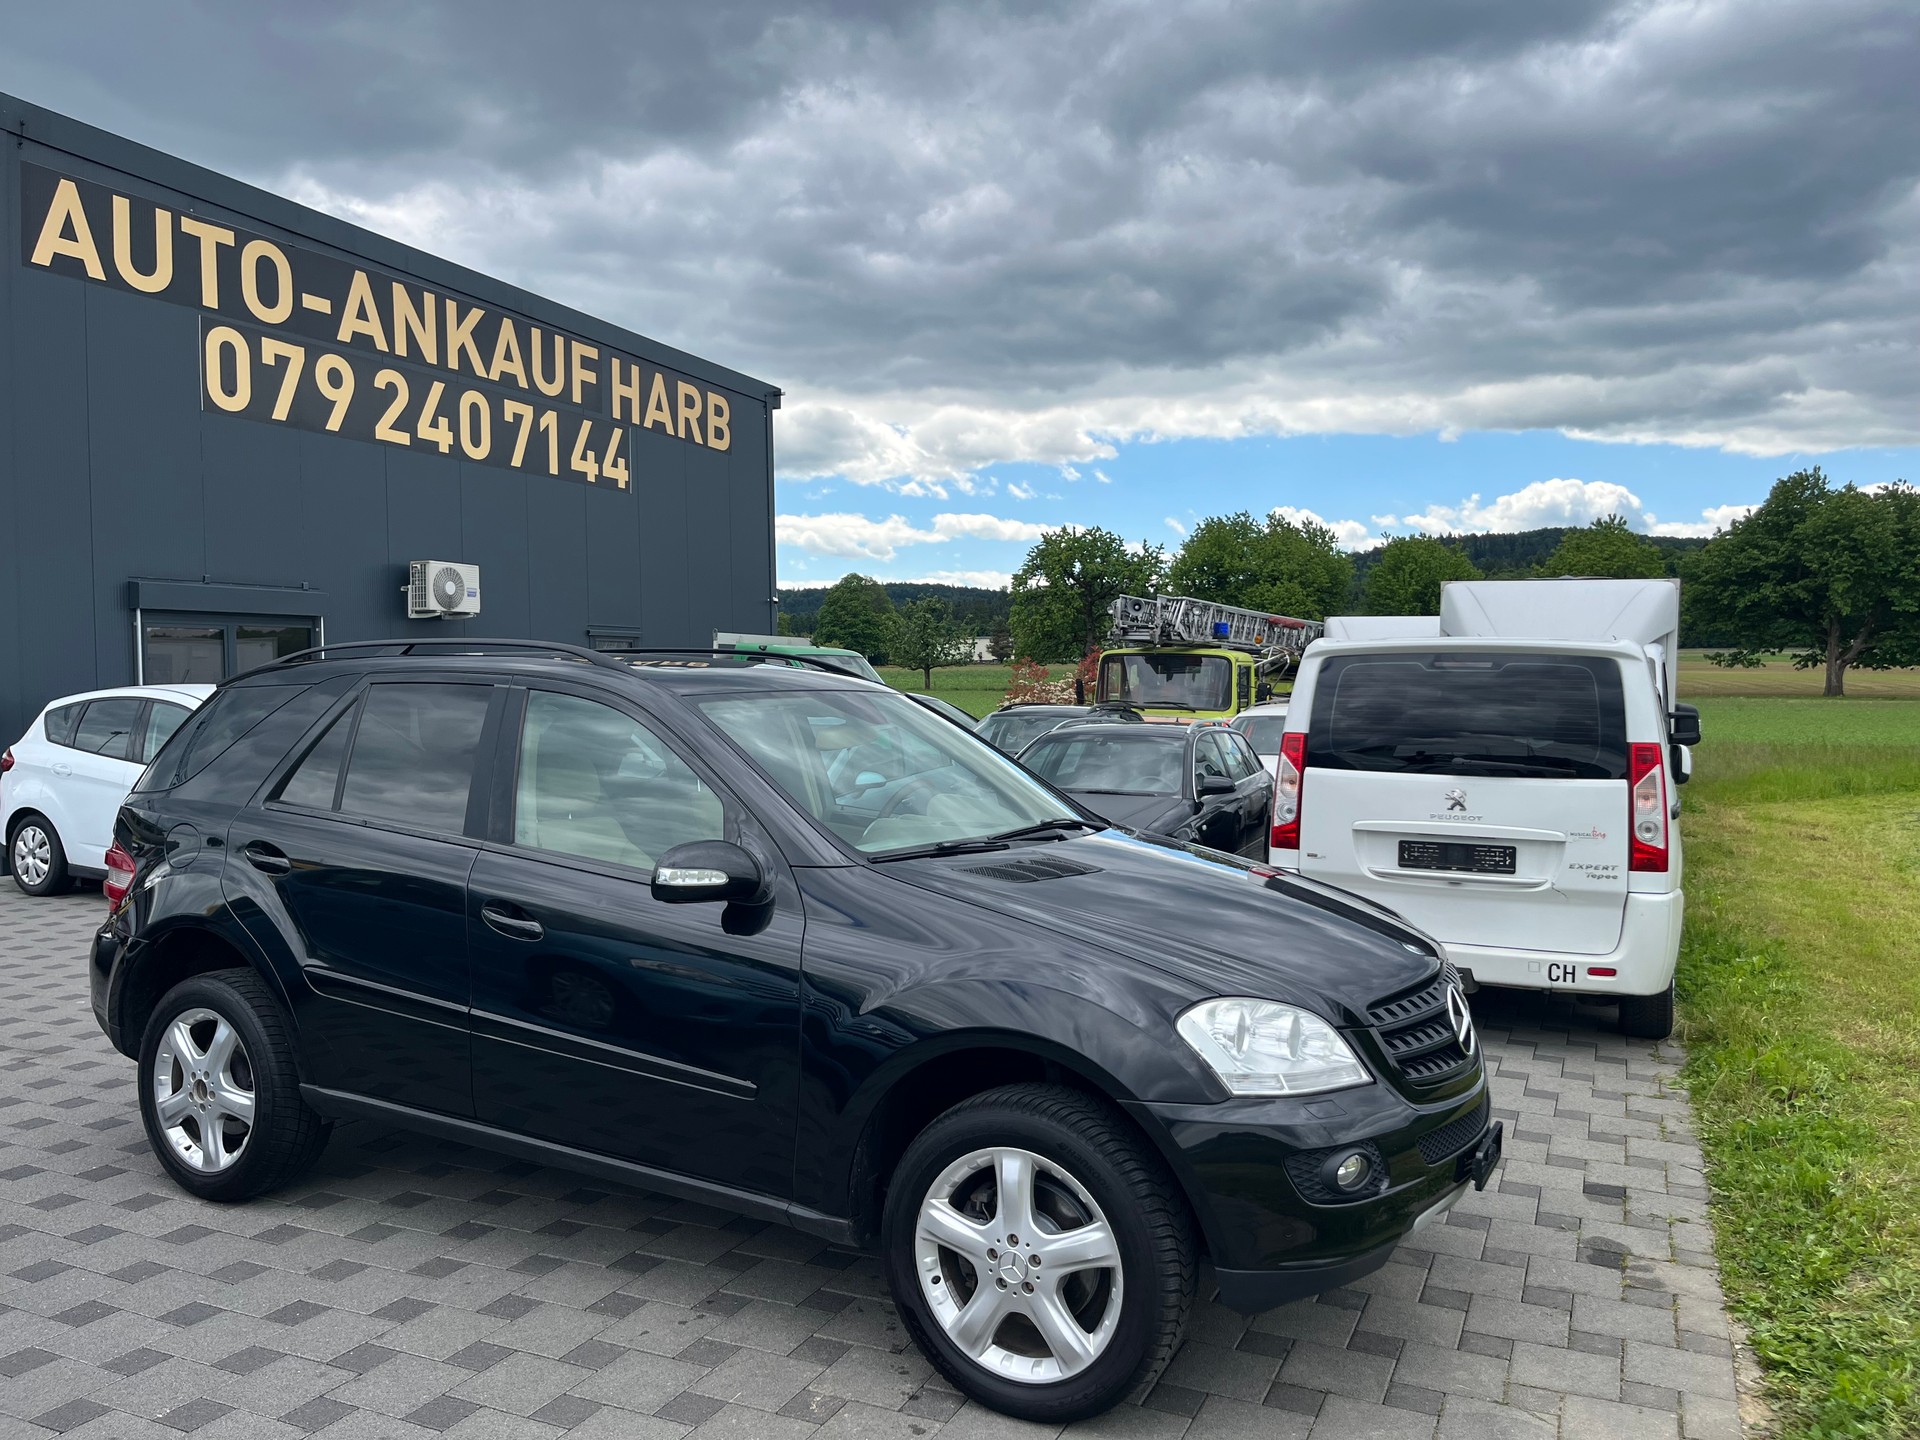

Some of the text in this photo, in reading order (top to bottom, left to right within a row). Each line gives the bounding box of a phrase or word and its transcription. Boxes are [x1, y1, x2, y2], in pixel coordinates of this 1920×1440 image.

[31, 178, 731, 451] AUTO-ANKAUF HARB
[205, 325, 356, 432] 079
[373, 368, 492, 461] 240
[1429, 813, 1483, 821] PEUGEOT
[1568, 863, 1619, 871] EXPERT
[1585, 872, 1618, 880] Tepee
[1548, 963, 1576, 983] CH
